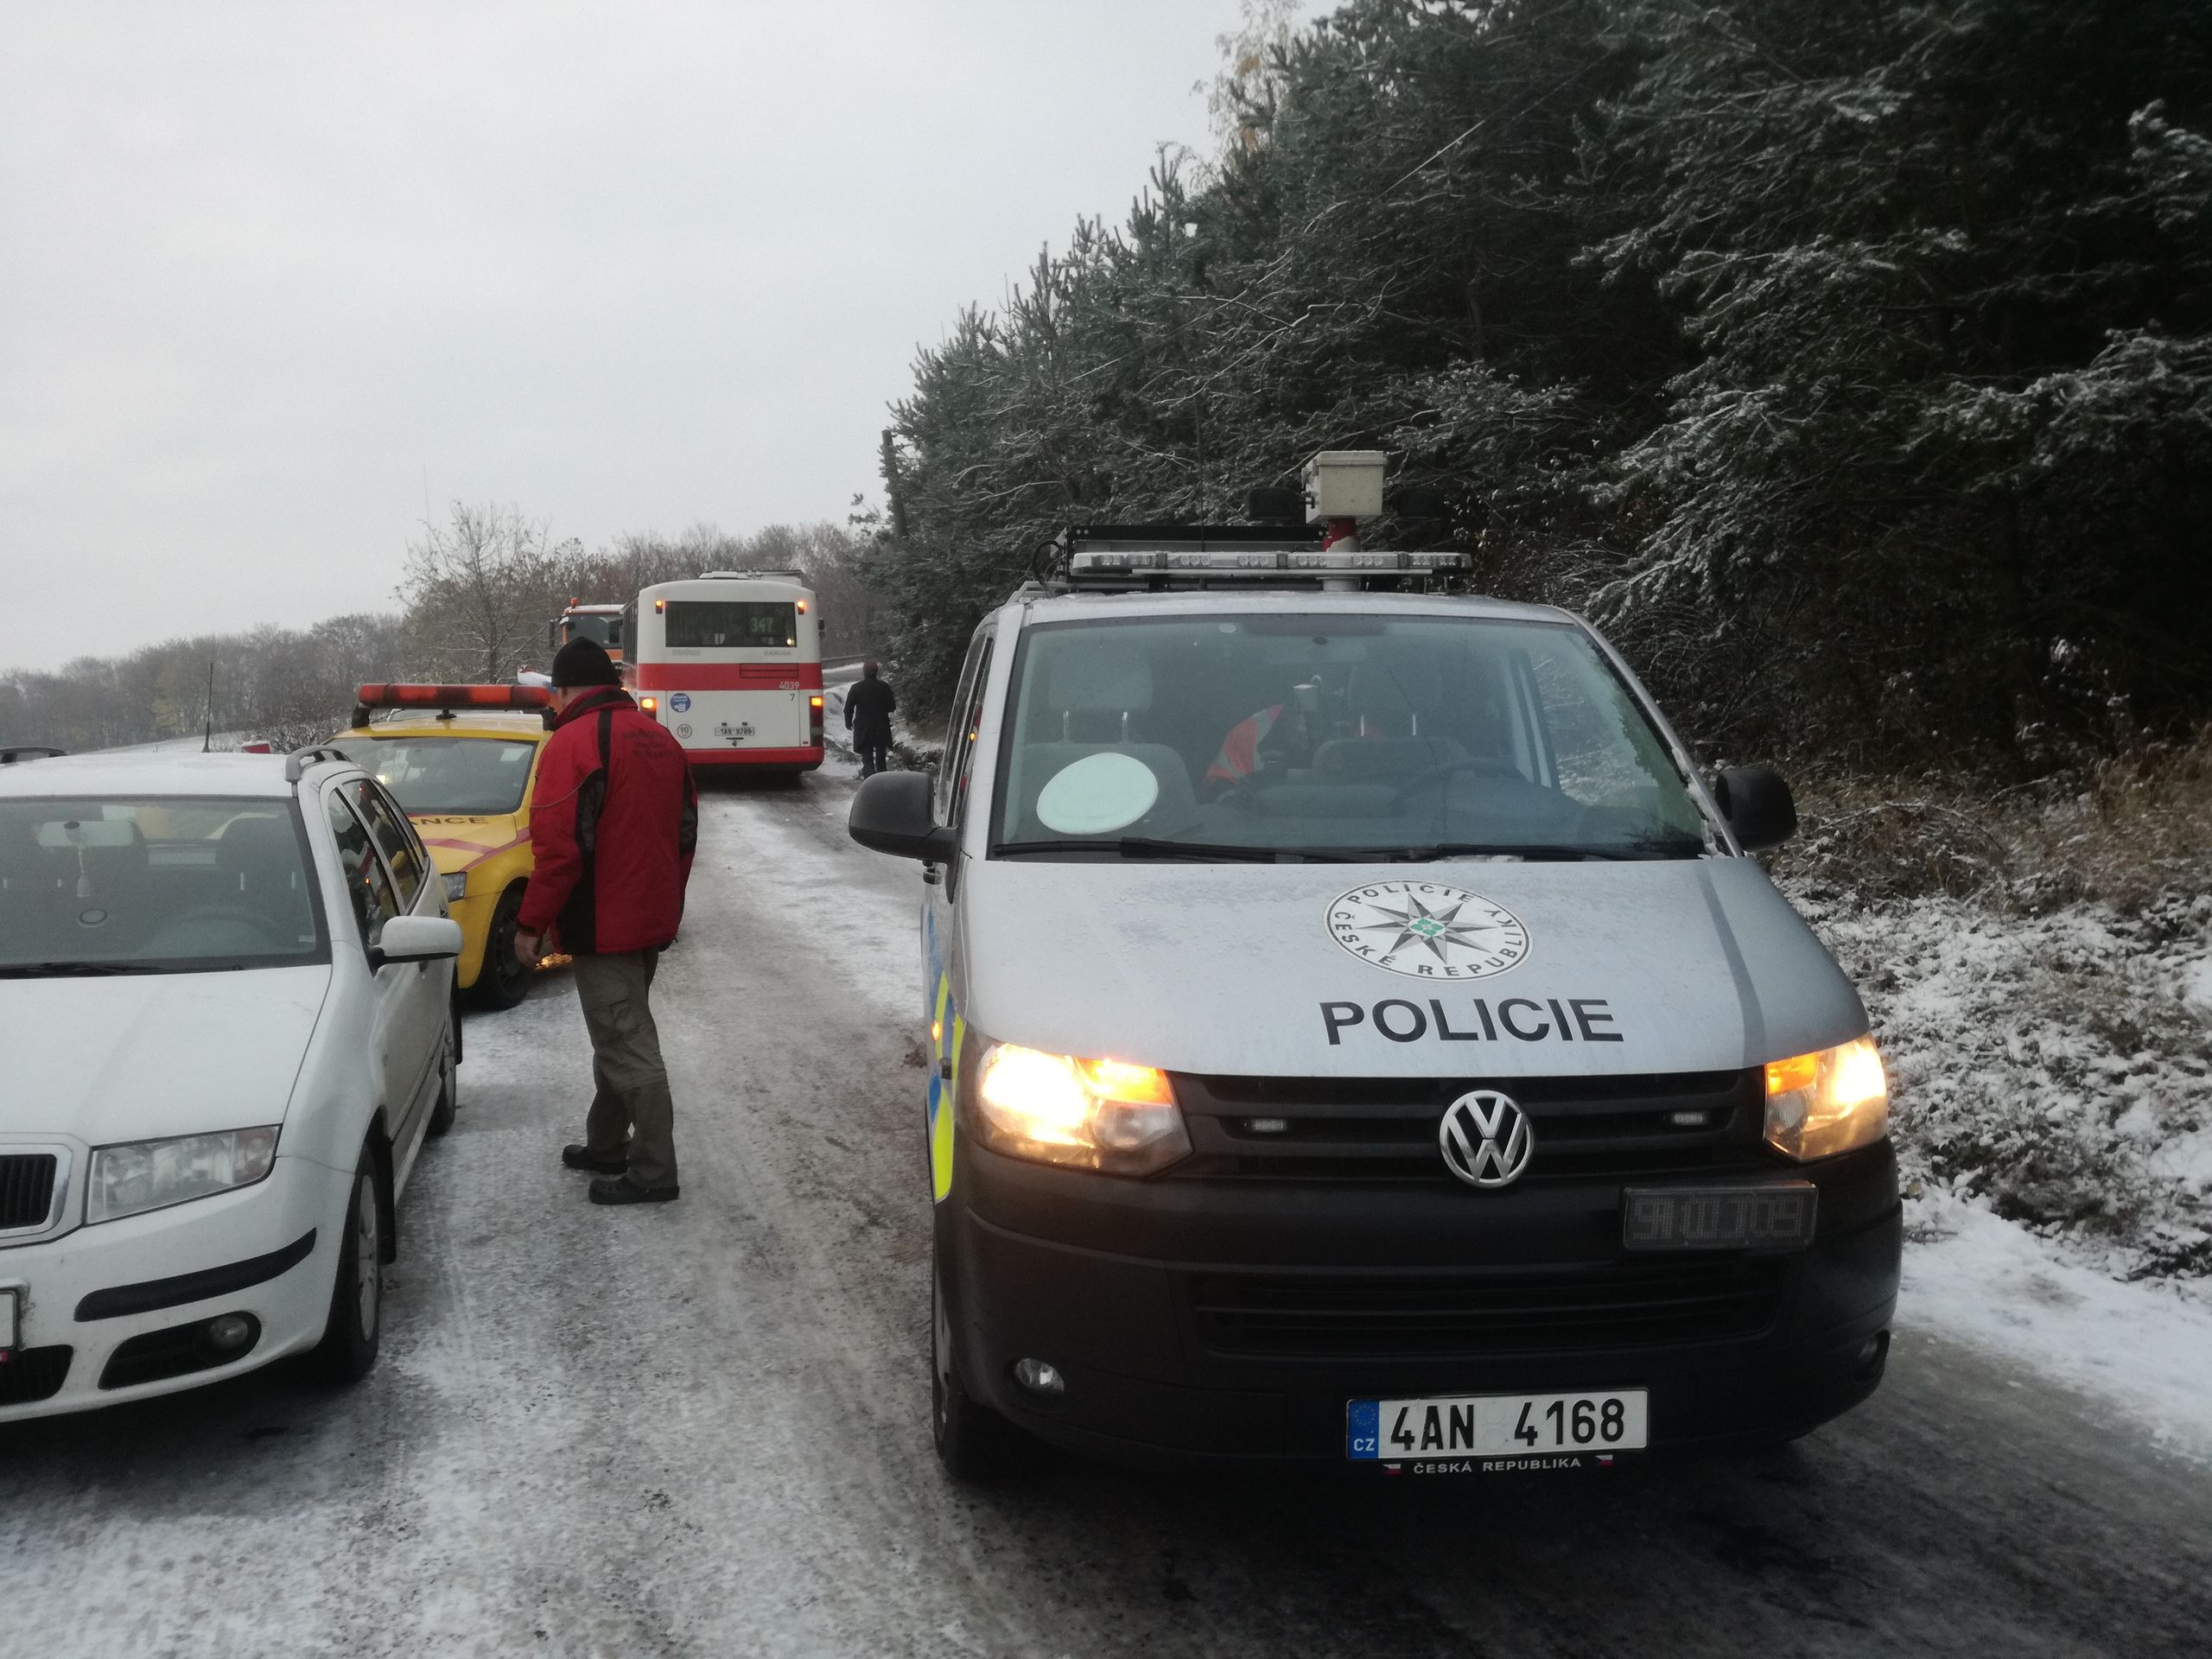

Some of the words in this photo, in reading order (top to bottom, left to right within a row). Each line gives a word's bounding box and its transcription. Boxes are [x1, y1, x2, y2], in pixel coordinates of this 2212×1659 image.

[779, 681, 800, 690] 4039
[410, 817, 489, 826] NCE
[1347, 884, 1475, 906] POLICIE
[1333, 911, 1397, 967] ČESKÉ
[1417, 907, 1523, 976] REPUBLIKY
[1319, 998, 1624, 1046] POLICIE
[1353, 1438, 1376, 1452] CZ
[1390, 1404, 1474, 1452] 4AN
[1514, 1398, 1624, 1447] 4168
[1413, 1461, 1472, 1475] ČESKÁ
[1483, 1457, 1582, 1471] REPUBLIKA
